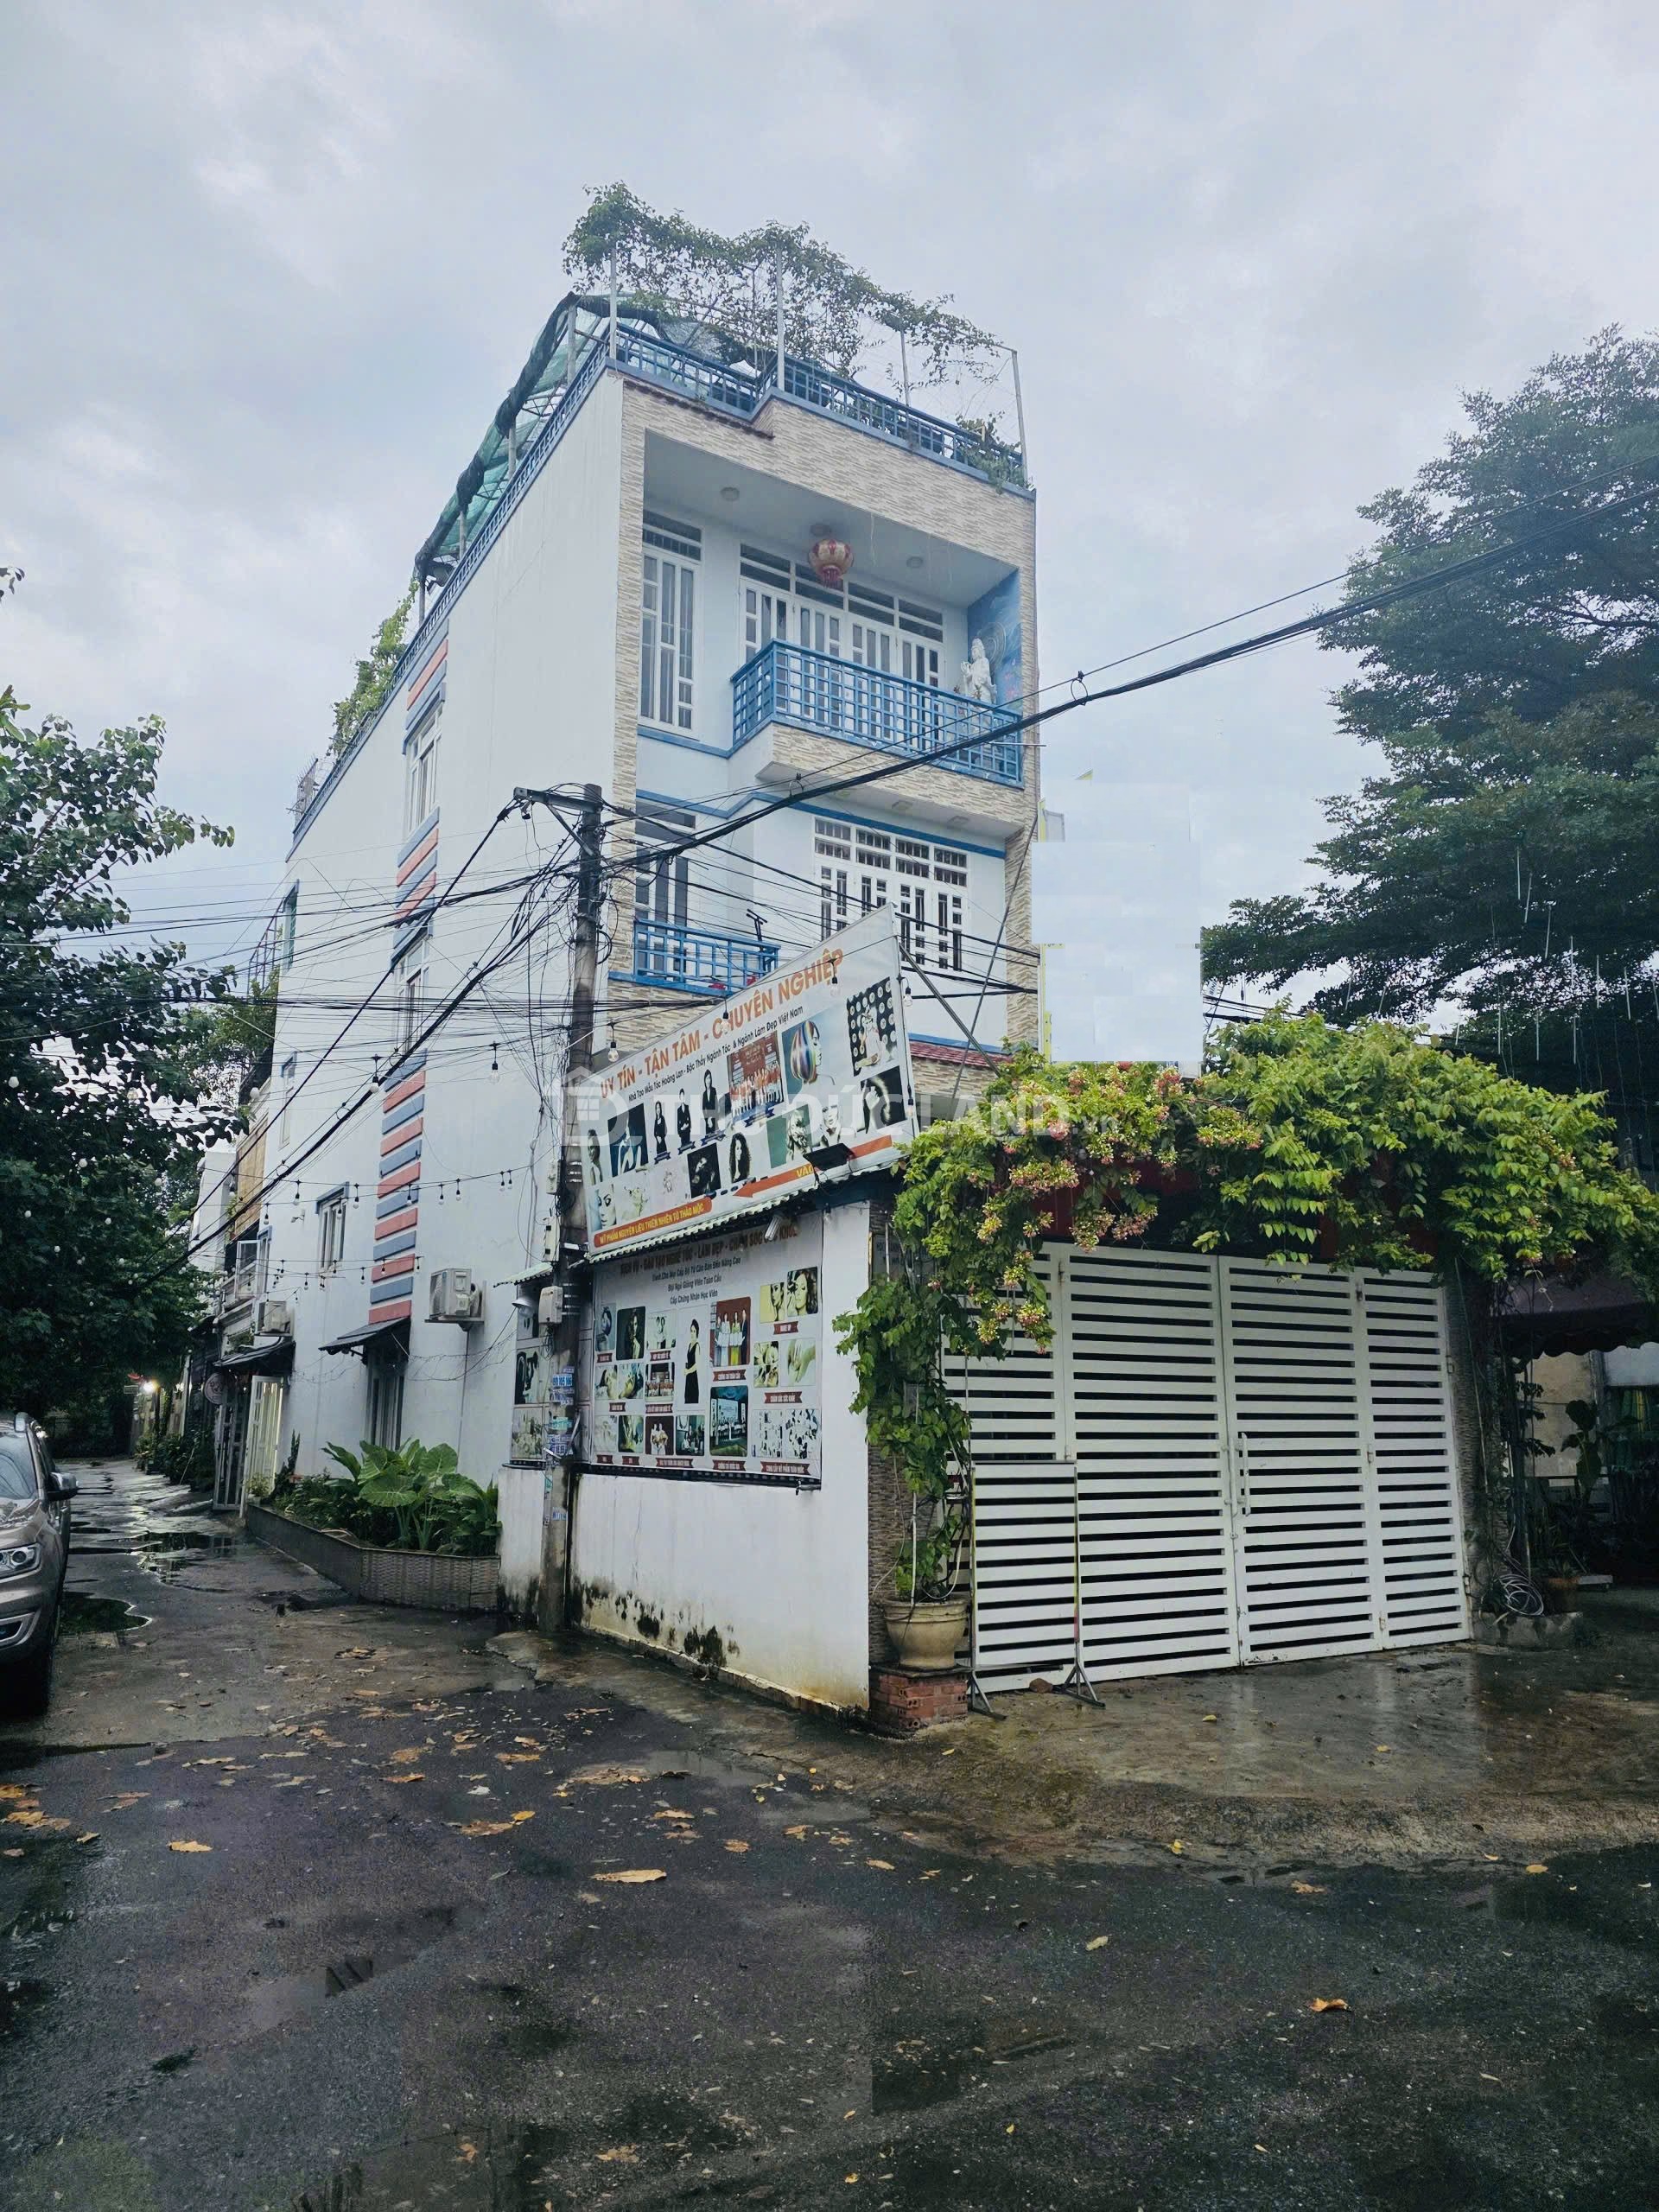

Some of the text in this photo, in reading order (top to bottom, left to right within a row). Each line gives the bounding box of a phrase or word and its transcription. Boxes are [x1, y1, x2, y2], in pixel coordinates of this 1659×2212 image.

[601, 1077, 614, 1099] UY
[617, 1064, 636, 1090] TÍN
[644, 1048, 670, 1078] TẬN
[672, 1030, 701, 1062] TÂM
[778, 948, 843, 1004] NGHIỆP
[675, 1069, 683, 1079] Lan
[766, 1019, 778, 1033] Đẹp
[778, 1013, 789, 1026] Việt
[790, 1005, 804, 1020] Nam
